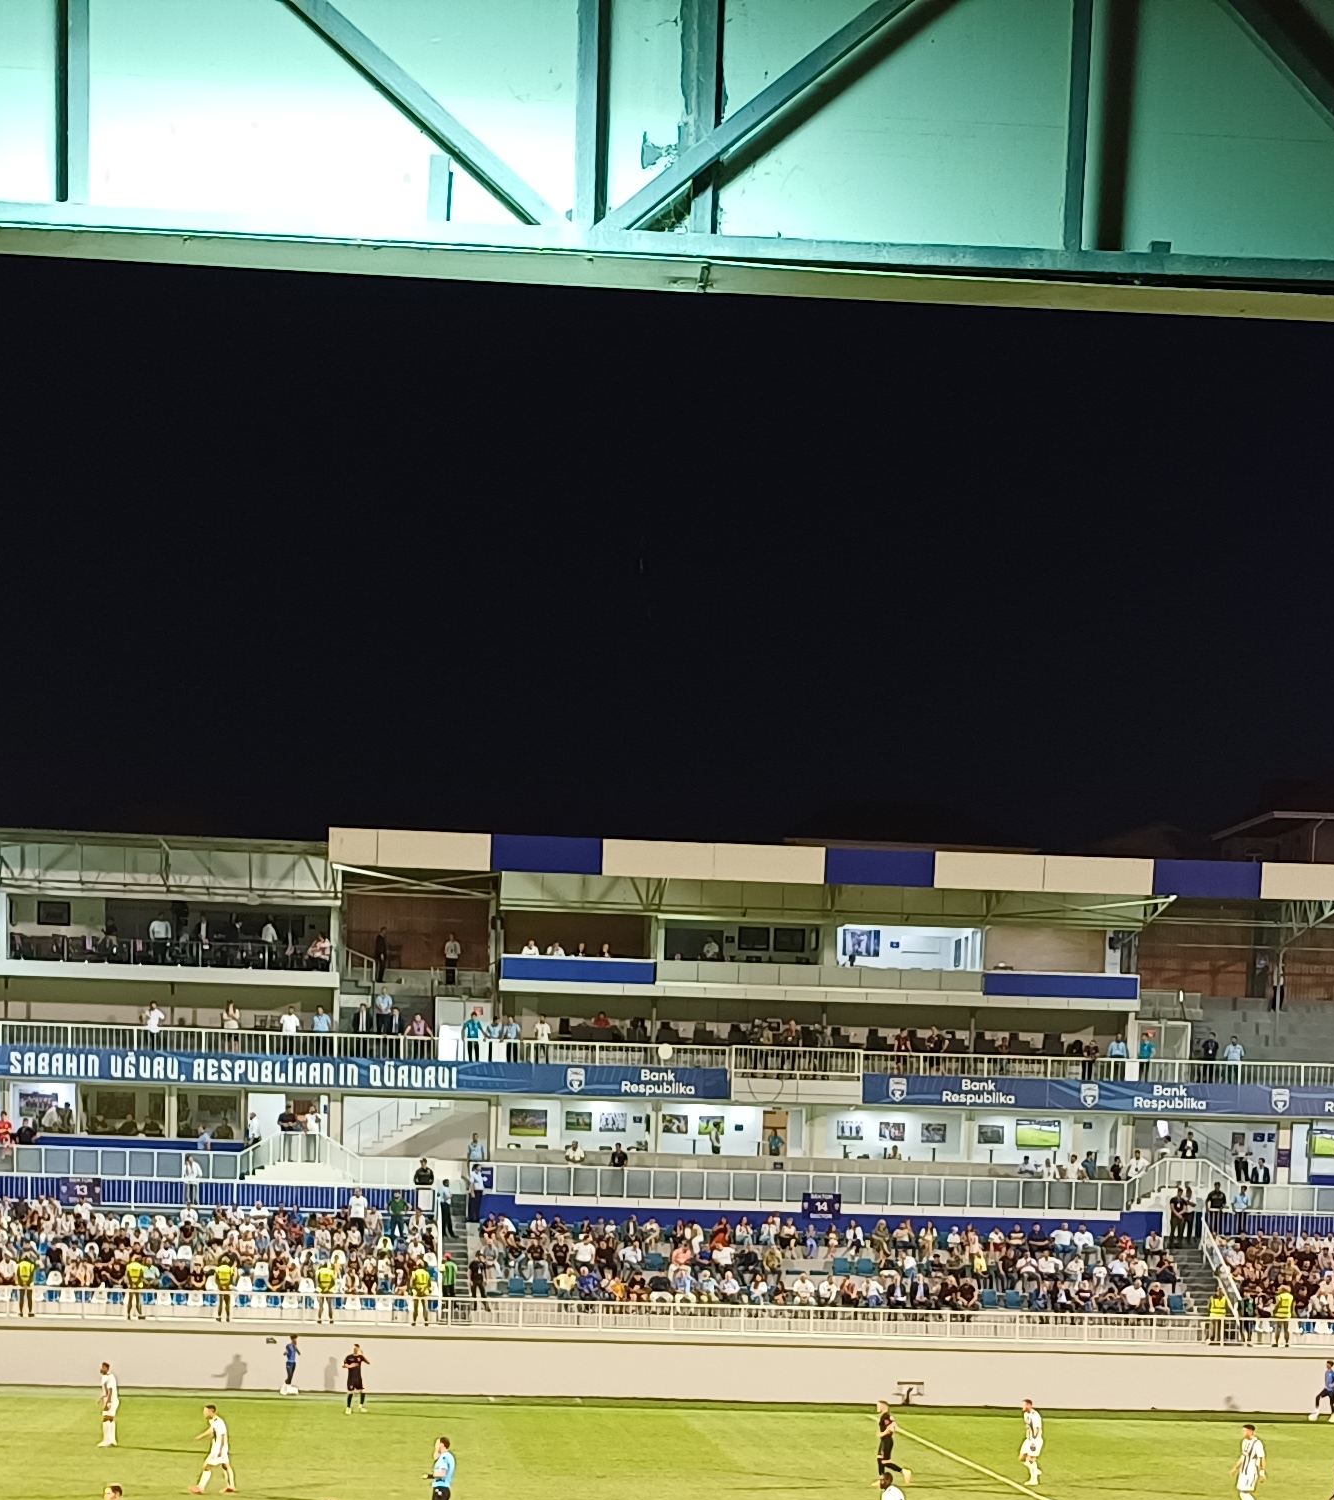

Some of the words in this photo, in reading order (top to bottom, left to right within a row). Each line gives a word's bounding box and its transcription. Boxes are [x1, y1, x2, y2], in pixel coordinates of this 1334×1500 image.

[9, 1051, 100, 1077] SABAHIN
[640, 1069, 675, 1081] Bank
[621, 1081, 695, 1096] Respublika
[961, 1078, 996, 1091] Bank
[1153, 1084, 1187, 1097] Bank
[942, 1090, 1015, 1106] Respublika
[1134, 1096, 1207, 1111] Respublika
[74, 1184, 88, 1196] 13
[815, 1201, 828, 1212] 14
